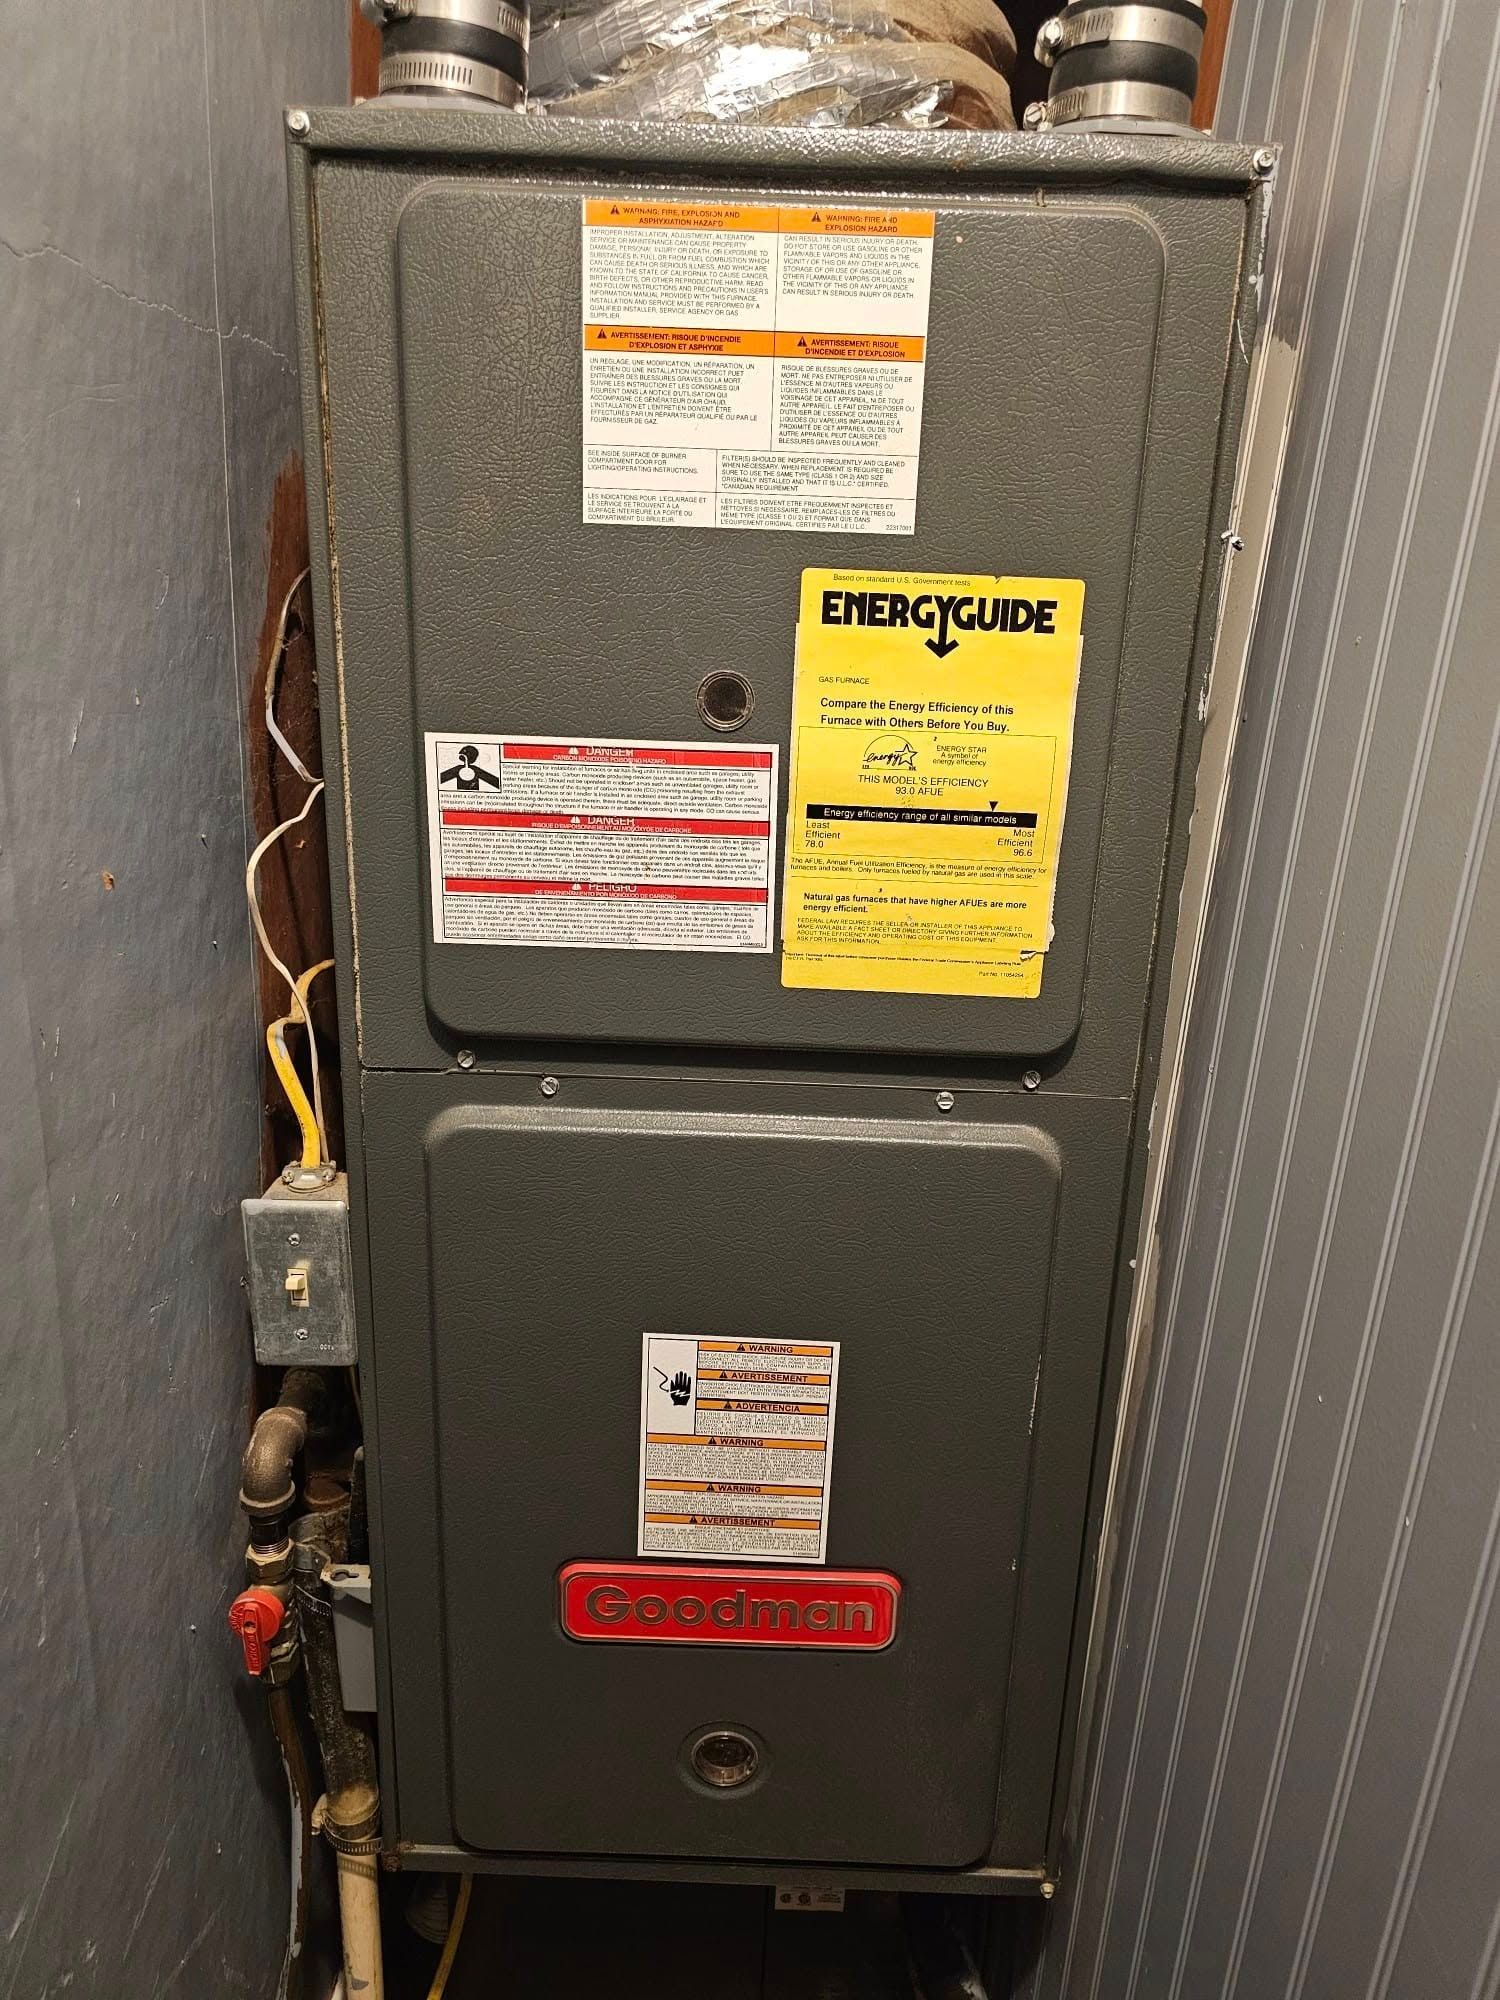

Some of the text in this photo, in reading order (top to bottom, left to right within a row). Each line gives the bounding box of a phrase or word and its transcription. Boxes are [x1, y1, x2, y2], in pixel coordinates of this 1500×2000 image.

[825, 224, 898, 233] EXPLOSION HAZARD
[611, 332, 741, 343] AVERTISSEMENT: RISQUE D'INCENDIE
[629, 341, 676, 350] D'EXPLOSION
[689, 343, 724, 352] ASPHYXIE
[811, 339, 870, 348] AVERTISSEMENT:
[805, 348, 846, 356] D'INCENDIE
[858, 350, 905, 358] D'EXPLOSION
[866, 575, 895, 583] standard
[912, 577, 954, 586] Government
[822, 590, 1057, 634] ENERGYGUIDE
[820, 698, 1013, 716] Compare the Energy Efficiency of this
[820, 714, 1010, 734] Furnace with Others Before You Buy.
[956, 758, 986, 767] efficiency
[858, 775, 882, 784] THIS
[930, 777, 988, 787] EFFICIENCY
[895, 786, 943, 796] 93.0 AFUE
[824, 808, 1016, 824] Energy efficiency range of all similar models
[806, 820, 830, 828] Least
[805, 830, 840, 839] Efficient
[1013, 829, 1035, 838] Most
[805, 840, 824, 848] 78.0
[998, 838, 1032, 847] Efficient
[1013, 848, 1032, 857] 96.6
[804, 893, 833, 902] Natural
[836, 896, 850, 904] gas
[851, 895, 888, 903] furnaces
[891, 896, 906, 904] that
[909, 896, 930, 905] have
[931, 897, 957, 908] higher
[959, 898, 987, 907] AFUEs
[749, 1344, 793, 1353] WARNING
[731, 1372, 808, 1383] AVERTISSEMENT
[736, 1403, 800, 1412] ADVERTENCIA
[720, 1438, 763, 1447] WARNING
[718, 1485, 761, 1493] WARNING
[701, 1517, 775, 1527] AVERTISSEMENT
[585, 1584, 874, 1632] Goodman
